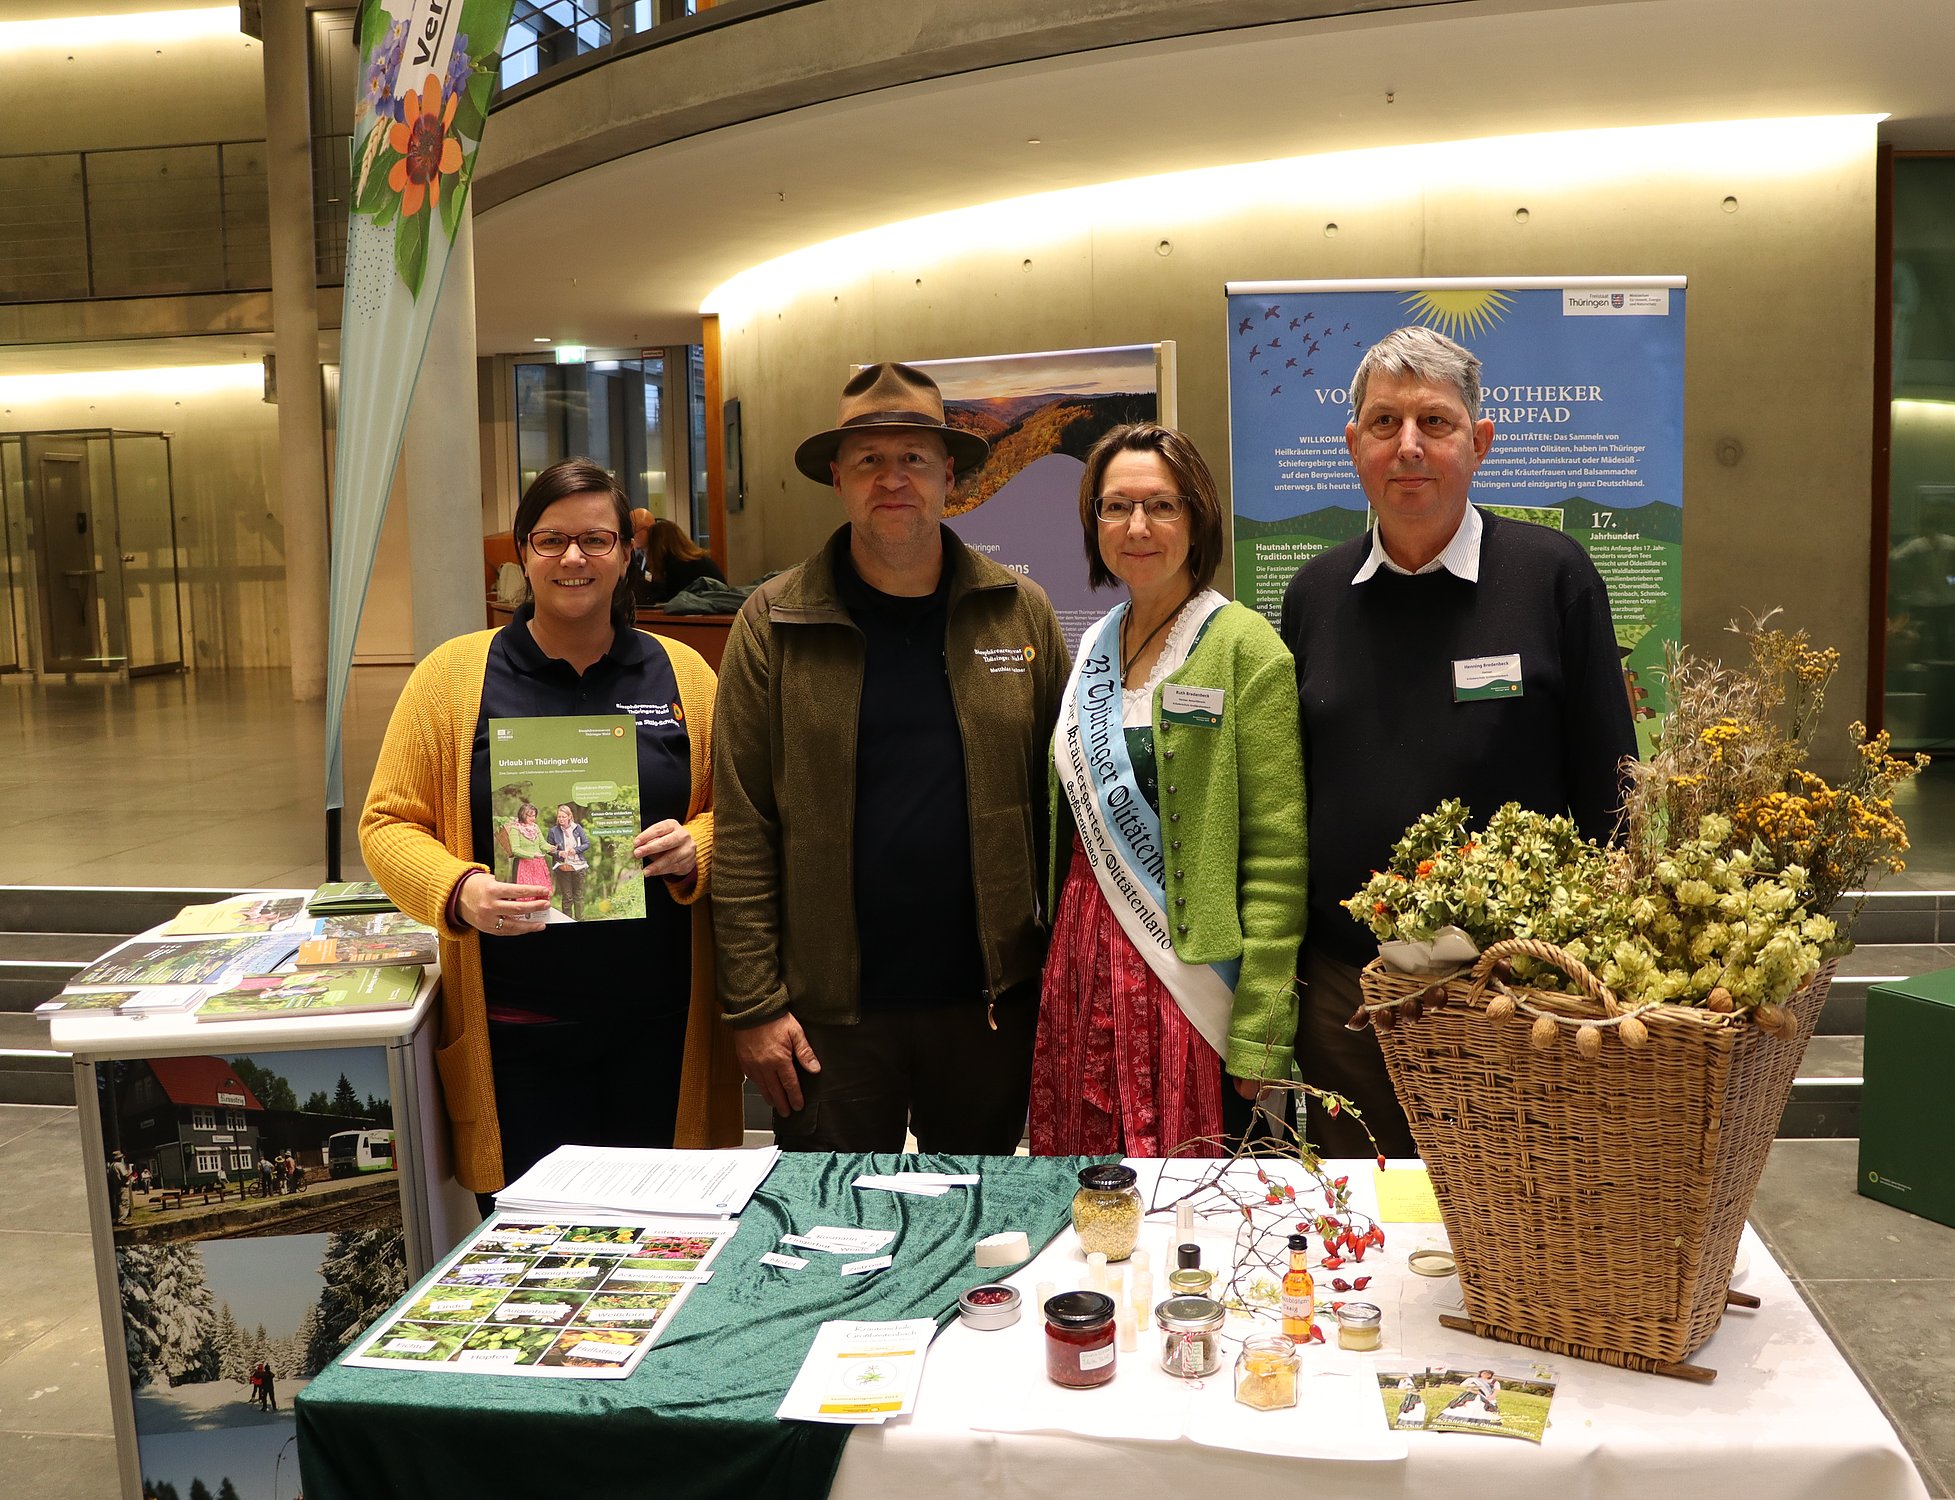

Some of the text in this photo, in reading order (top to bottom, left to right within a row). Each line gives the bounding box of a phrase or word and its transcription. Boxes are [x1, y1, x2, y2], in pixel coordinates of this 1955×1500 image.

[1568, 297, 1610, 308] Thüringen
[1509, 432, 1552, 441] OLITÄTEN:
[1553, 433, 1568, 441] Das
[1569, 433, 1604, 441] Sammeln
[1274, 448, 1321, 456] Heilkräutern
[1322, 447, 1337, 455] und
[1491, 446, 1539, 454] sogenannten
[1540, 445, 1573, 453] Olitäten,
[1573, 444, 1598, 452] haben
[1598, 444, 1608, 452] im
[1609, 444, 1646, 454] Thüringer
[1278, 459, 1336, 468] Schiefergebirge
[1528, 457, 1581, 465] Johanniskraut
[1600, 456, 1635, 464] Mädesüß
[1281, 471, 1294, 479] auf
[1295, 471, 1310, 479] den
[1311, 470, 1356, 480] Bergwiesen,
[1501, 468, 1514, 476] die
[1514, 467, 1566, 476] Kräuterfrauen
[1583, 467, 1637, 475] Balsammacher
[1274, 484, 1316, 492] unterwegs.
[1316, 482, 1328, 490] Bis
[1328, 482, 1350, 490] heute
[1351, 482, 1361, 490] ist
[1472, 480, 1511, 489] Thüringen
[1527, 479, 1567, 489] einzigartig
[1568, 479, 1576, 487] in
[1576, 480, 1596, 488] ganz
[1596, 479, 1646, 488] Deutschland.
[1591, 511, 1618, 529] 17.
[1589, 532, 1640, 541] Jahrhundert
[1255, 543, 1291, 551] Hautnah
[1291, 543, 1323, 551] erleben
[1610, 545, 1632, 553] Anfang
[1255, 552, 1310, 561] Tradition lebt
[1082, 679, 1119, 785] Thüringer
[498, 757, 589, 767] Urlaub im Thüringer Wald
